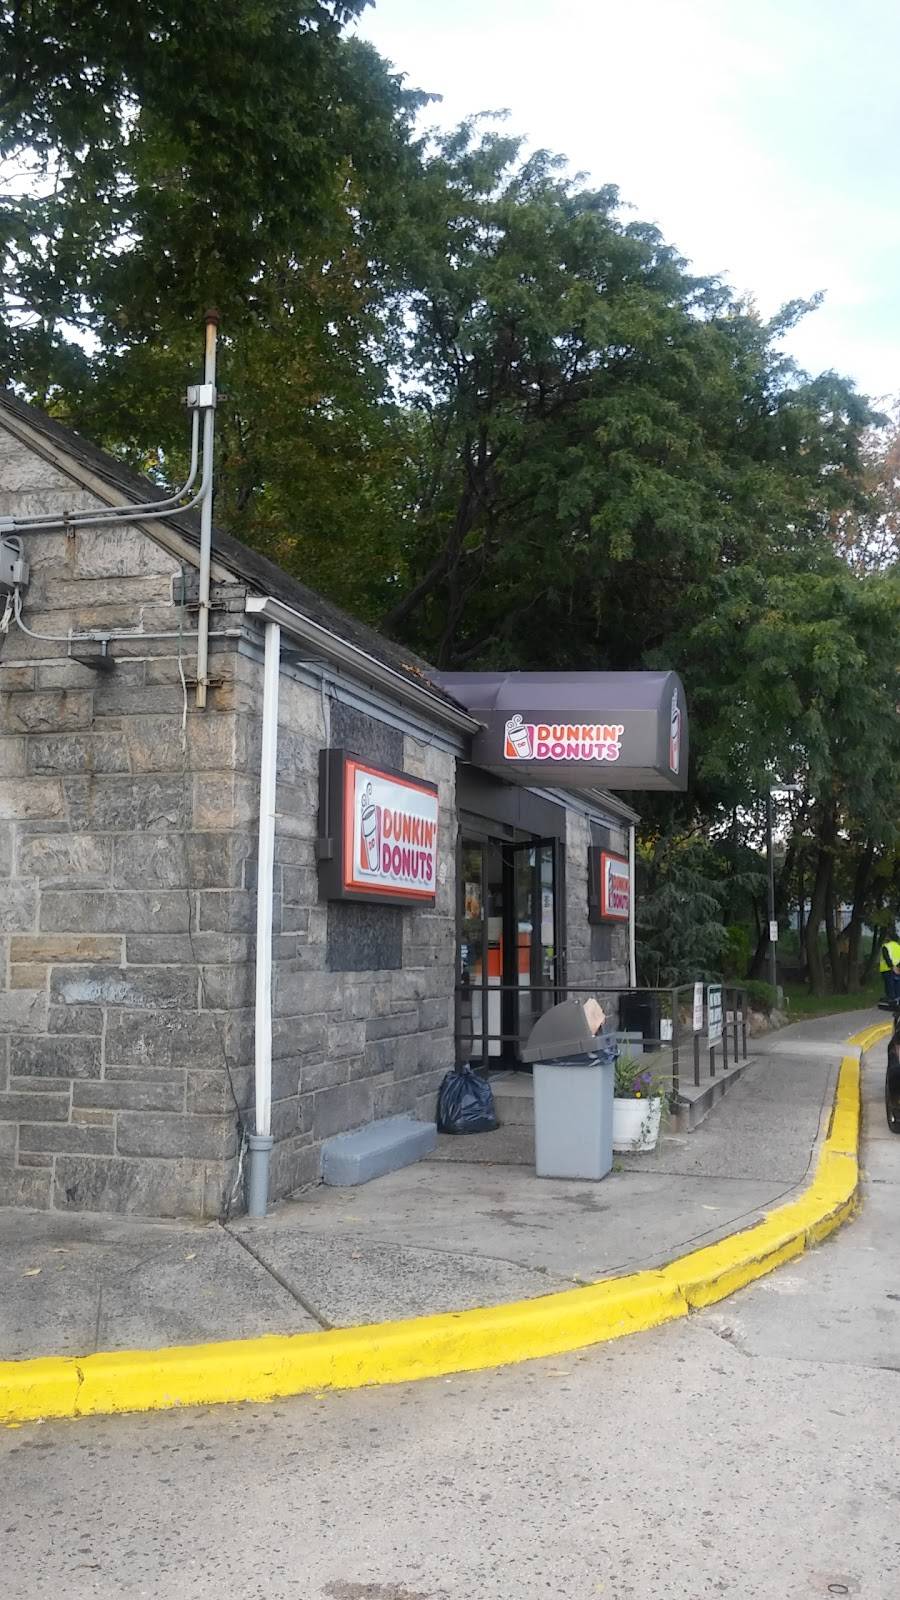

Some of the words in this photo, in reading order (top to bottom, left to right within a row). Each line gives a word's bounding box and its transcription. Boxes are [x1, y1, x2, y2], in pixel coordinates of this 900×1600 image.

[537, 726, 623, 741] DUNKIN'
[537, 742, 619, 758] DONUTS
[383, 807, 436, 849] DUNKIN'
[382, 843, 433, 881] DONUTS
